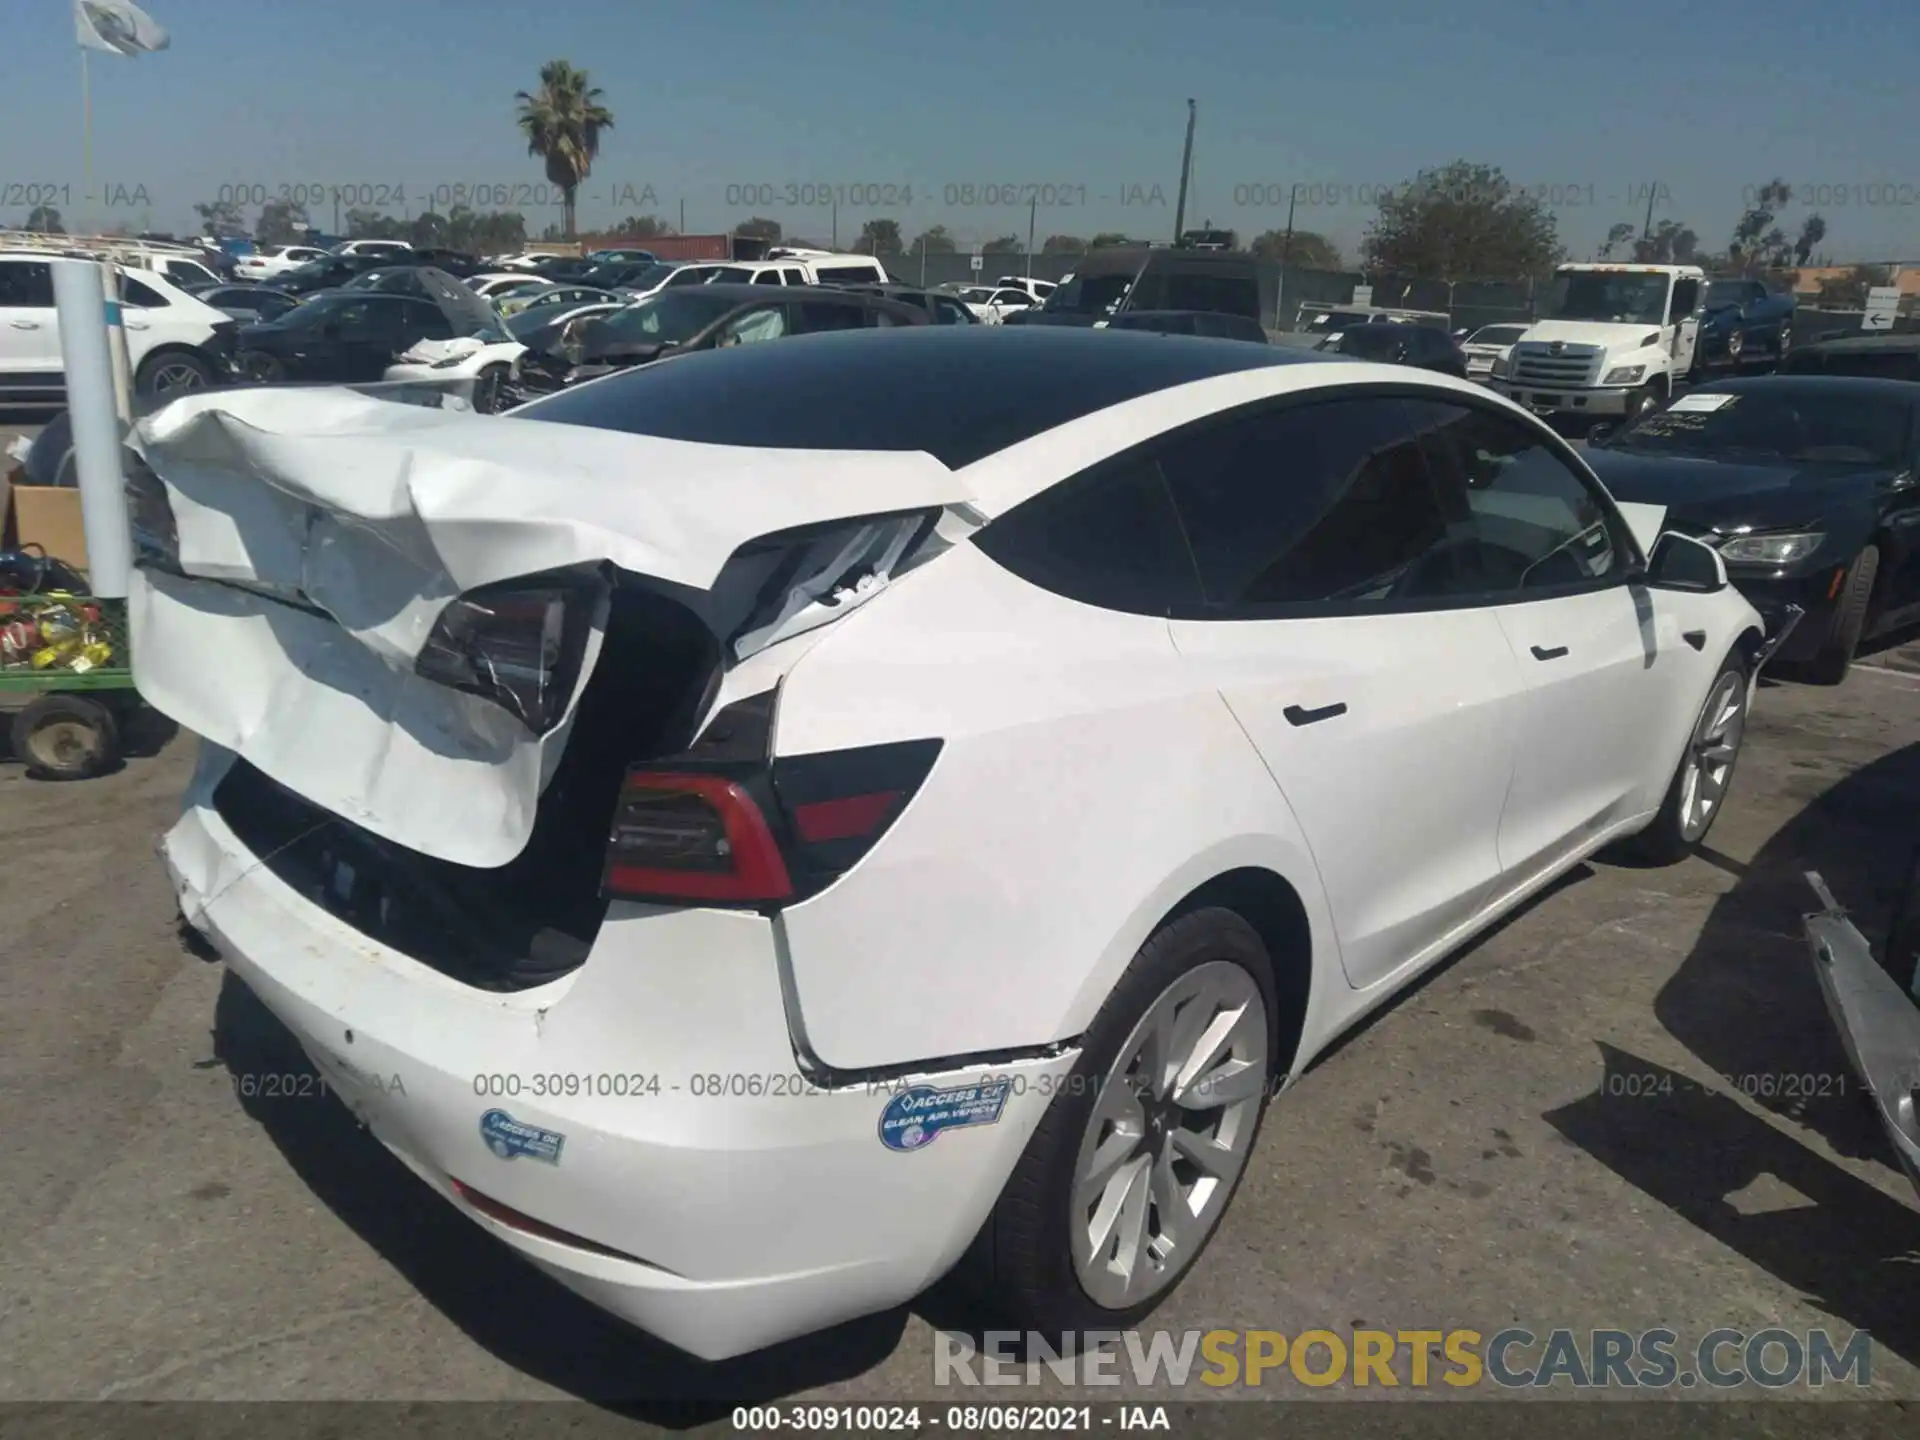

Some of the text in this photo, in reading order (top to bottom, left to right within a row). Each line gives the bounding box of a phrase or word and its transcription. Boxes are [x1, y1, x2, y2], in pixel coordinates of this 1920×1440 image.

[912, 1088, 977, 1109] ACCESS
[884, 1115, 924, 1128] CLEAN
[927, 1110, 949, 1121] AIR
